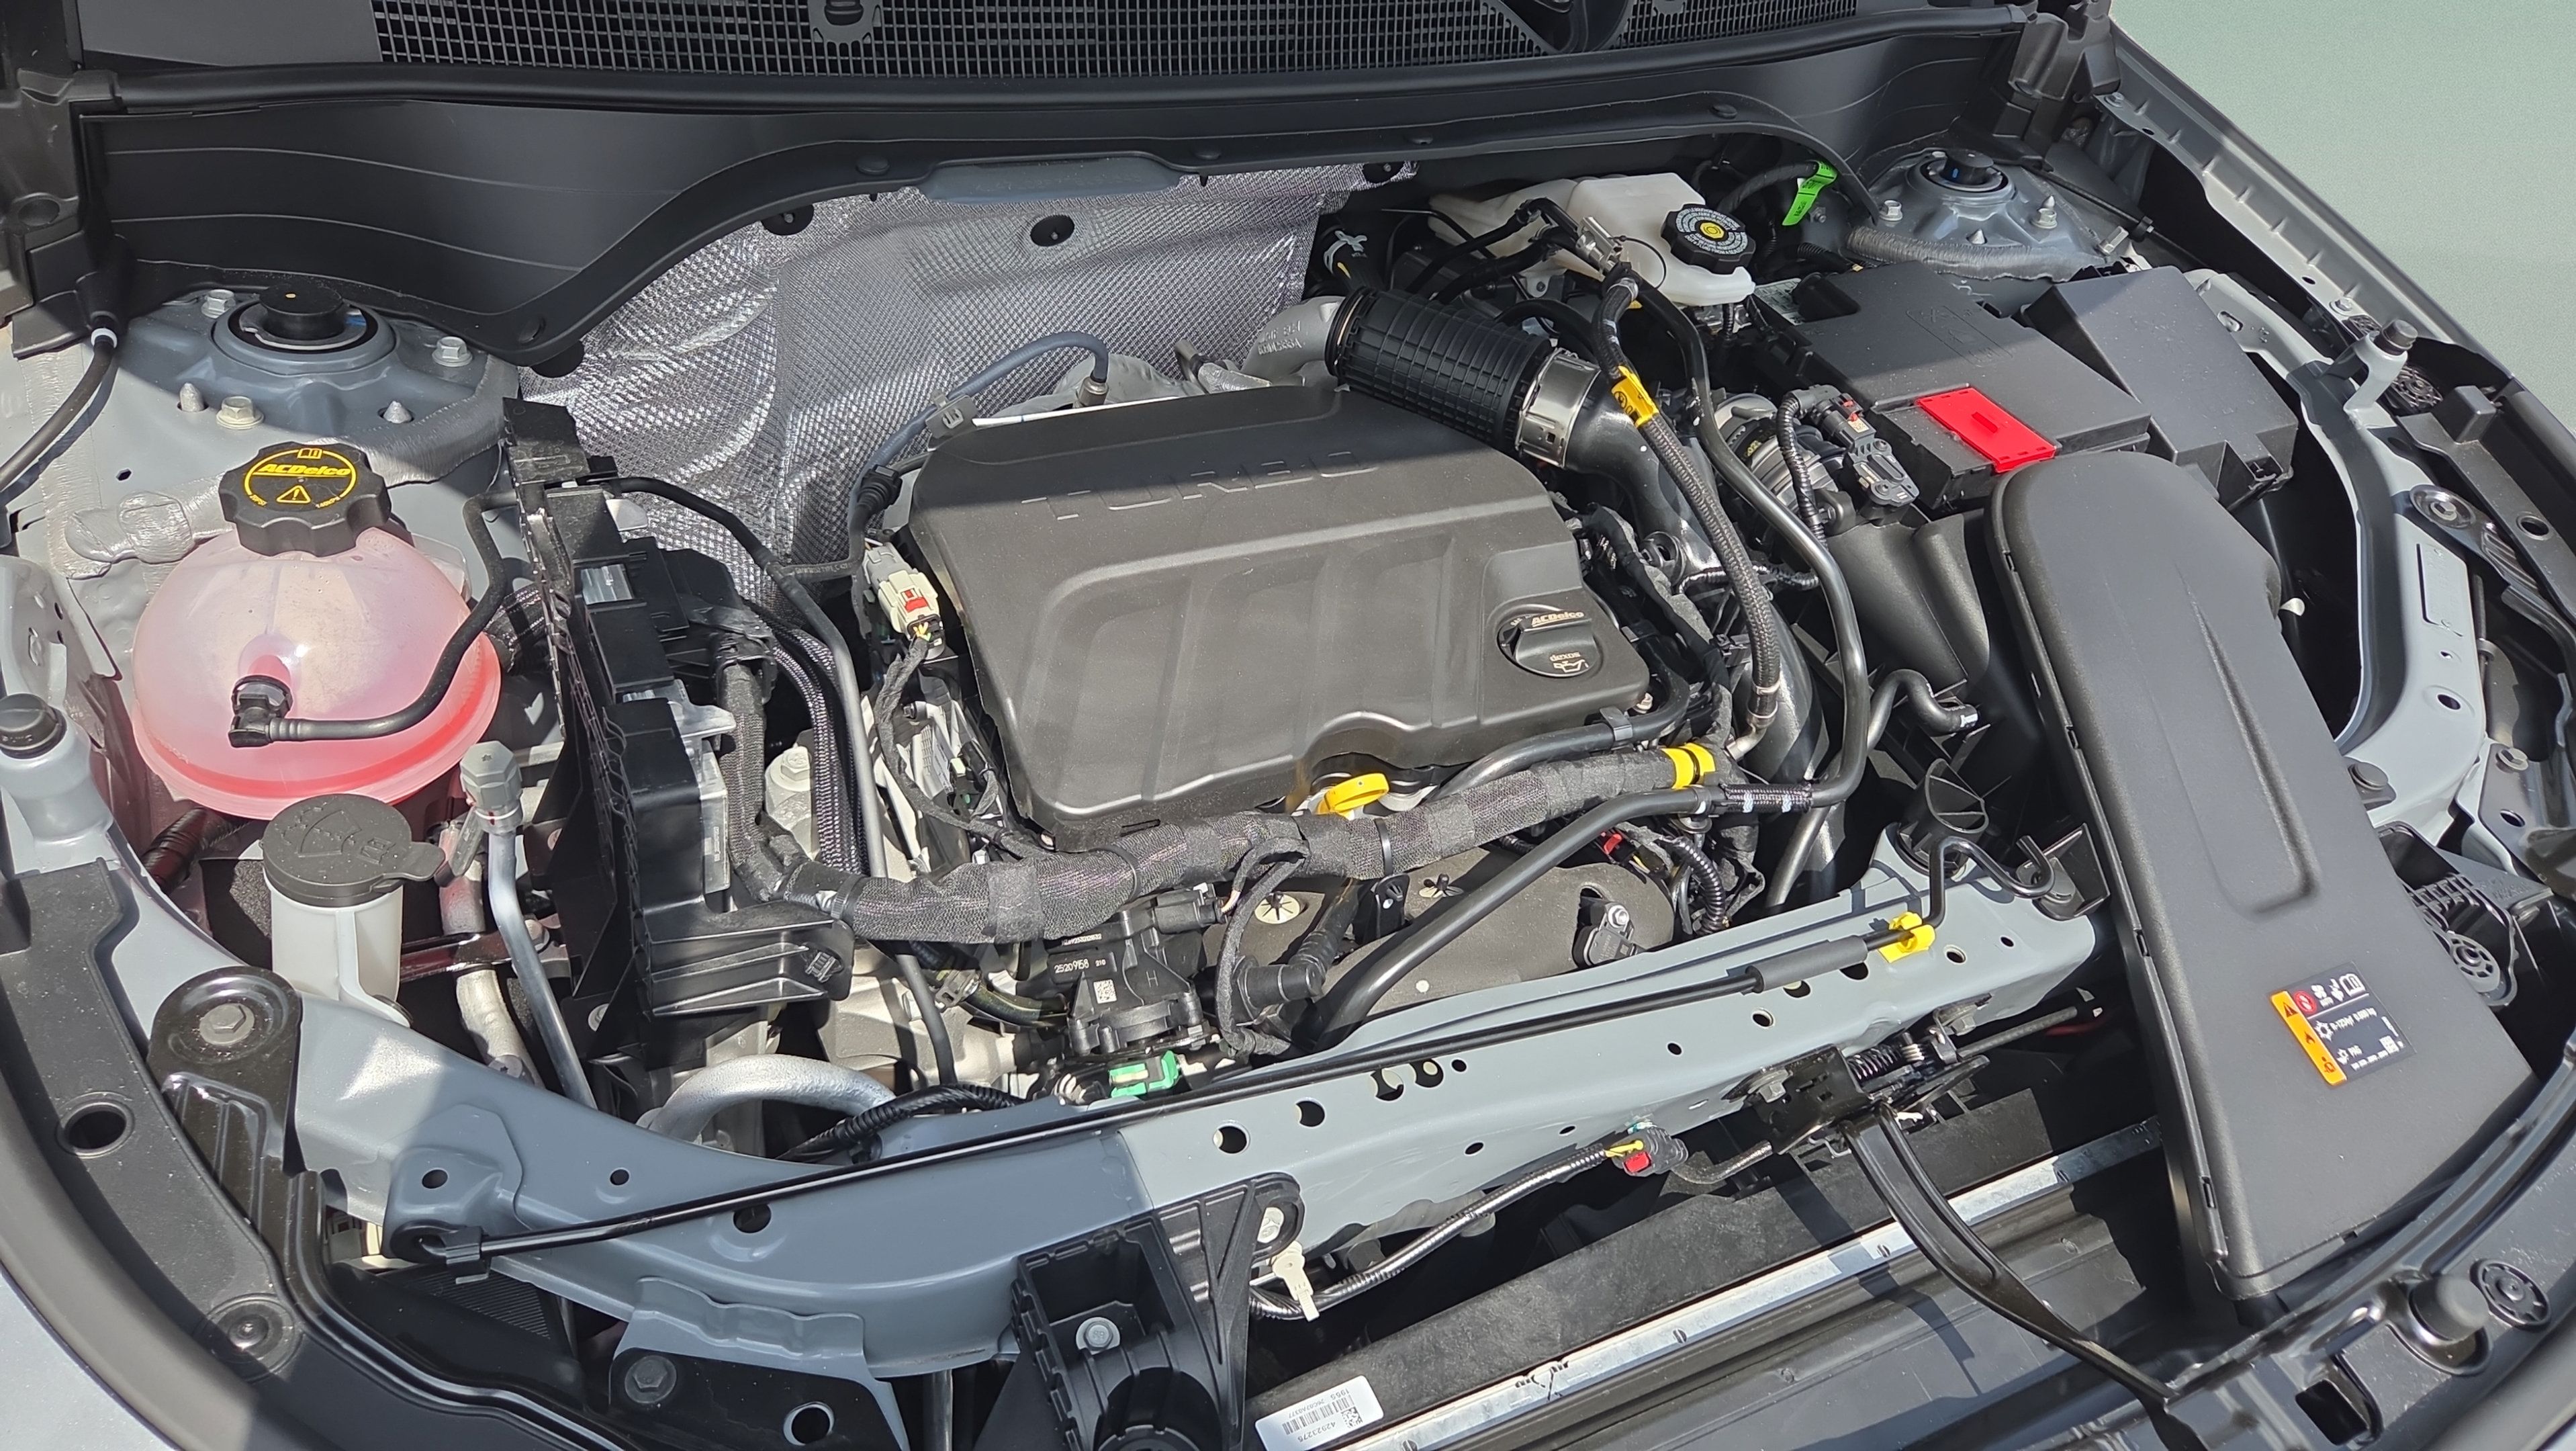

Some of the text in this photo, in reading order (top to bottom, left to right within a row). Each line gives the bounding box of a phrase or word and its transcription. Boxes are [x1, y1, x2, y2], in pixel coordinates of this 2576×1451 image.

[257, 464, 351, 476] ACDelco
[1021, 451, 1379, 520] TURBO
[1531, 611, 1585, 625] ACDelco
[1549, 651, 1581, 662] dexos
